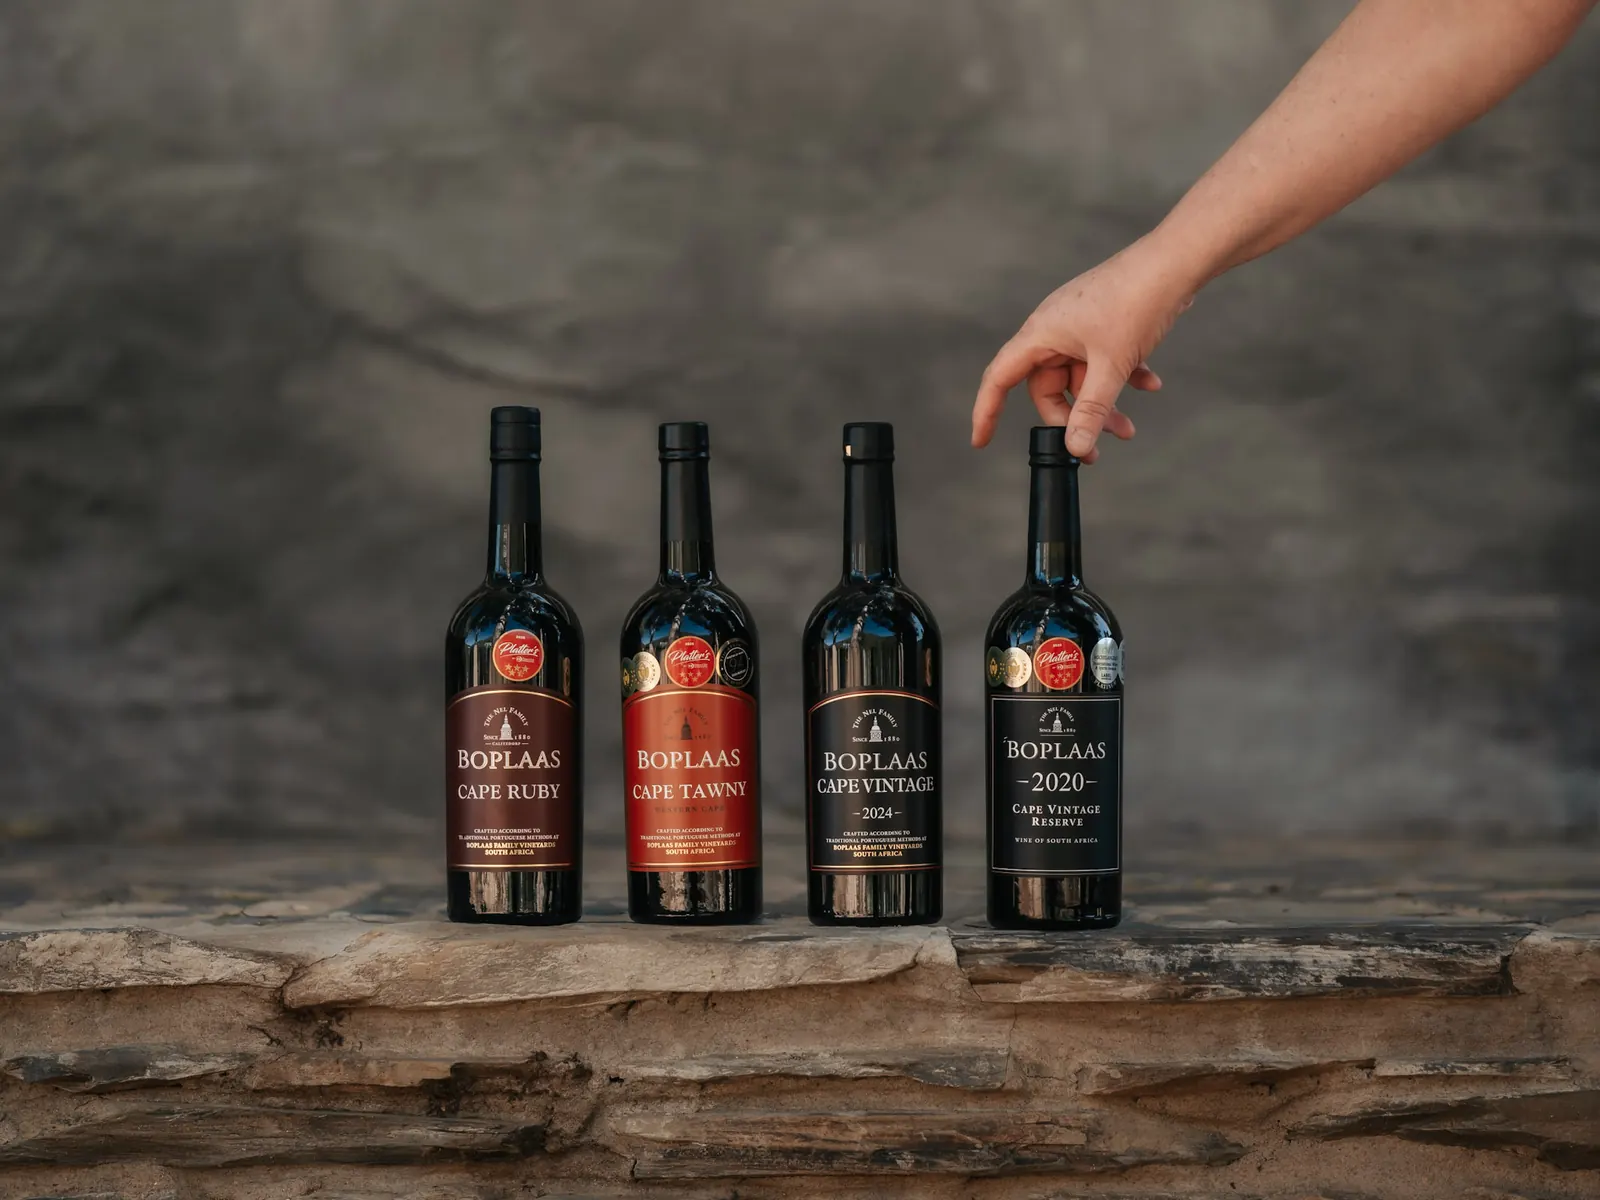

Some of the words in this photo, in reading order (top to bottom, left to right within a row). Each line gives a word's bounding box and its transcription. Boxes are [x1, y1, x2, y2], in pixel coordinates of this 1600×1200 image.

[498, 641, 540, 657] Platter's
[668, 649, 711, 665] Platter's
[1037, 650, 1079, 666] Platter's
[483, 713, 494, 727] THE
[493, 707, 508, 715] NEL
[509, 707, 529, 726] FAMILY
[852, 715, 863, 729] THE
[862, 708, 877, 718] NEL
[878, 708, 898, 728] FAMILY
[1060, 707, 1075, 722] FAMILY
[1007, 740, 1106, 759] BOPLAAS
[458, 749, 561, 770] BOPLAAS
[637, 748, 741, 770] BOPLAAS
[824, 751, 928, 771] BOPLAAS
[458, 784, 502, 800] CAPE
[507, 783, 561, 800] RUBY
[633, 784, 674, 800] CAPE
[679, 781, 747, 799] TAWNY
[817, 778, 860, 794] CAPE
[862, 776, 934, 793] VINTAGE
[701, 805, 725, 813] CAPE
[1012, 803, 1043, 814] CAPE
[1047, 804, 1101, 814] VINTAGE
[1031, 816, 1083, 827] RESERVE
